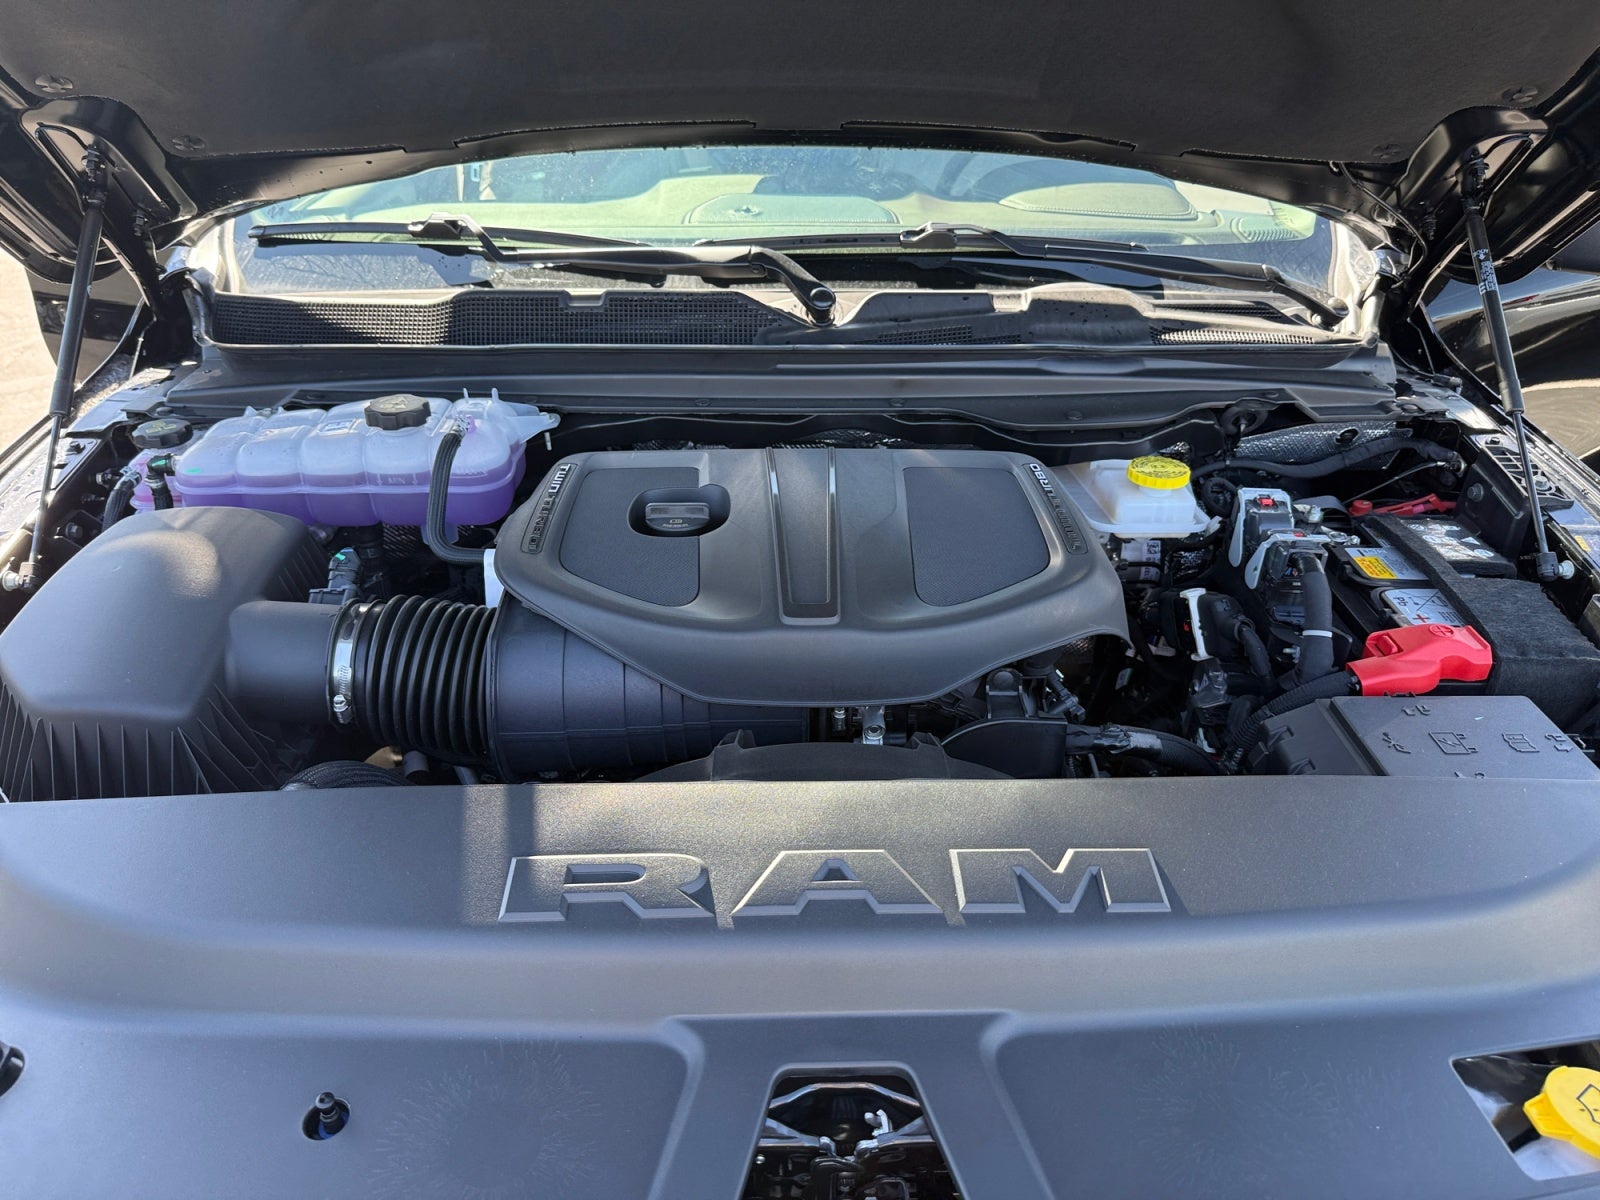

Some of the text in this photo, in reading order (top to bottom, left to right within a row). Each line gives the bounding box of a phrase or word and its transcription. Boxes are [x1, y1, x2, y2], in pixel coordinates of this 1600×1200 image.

[527, 463, 571, 550] TWIN TURBO
[499, 848, 1171, 922] RAM
